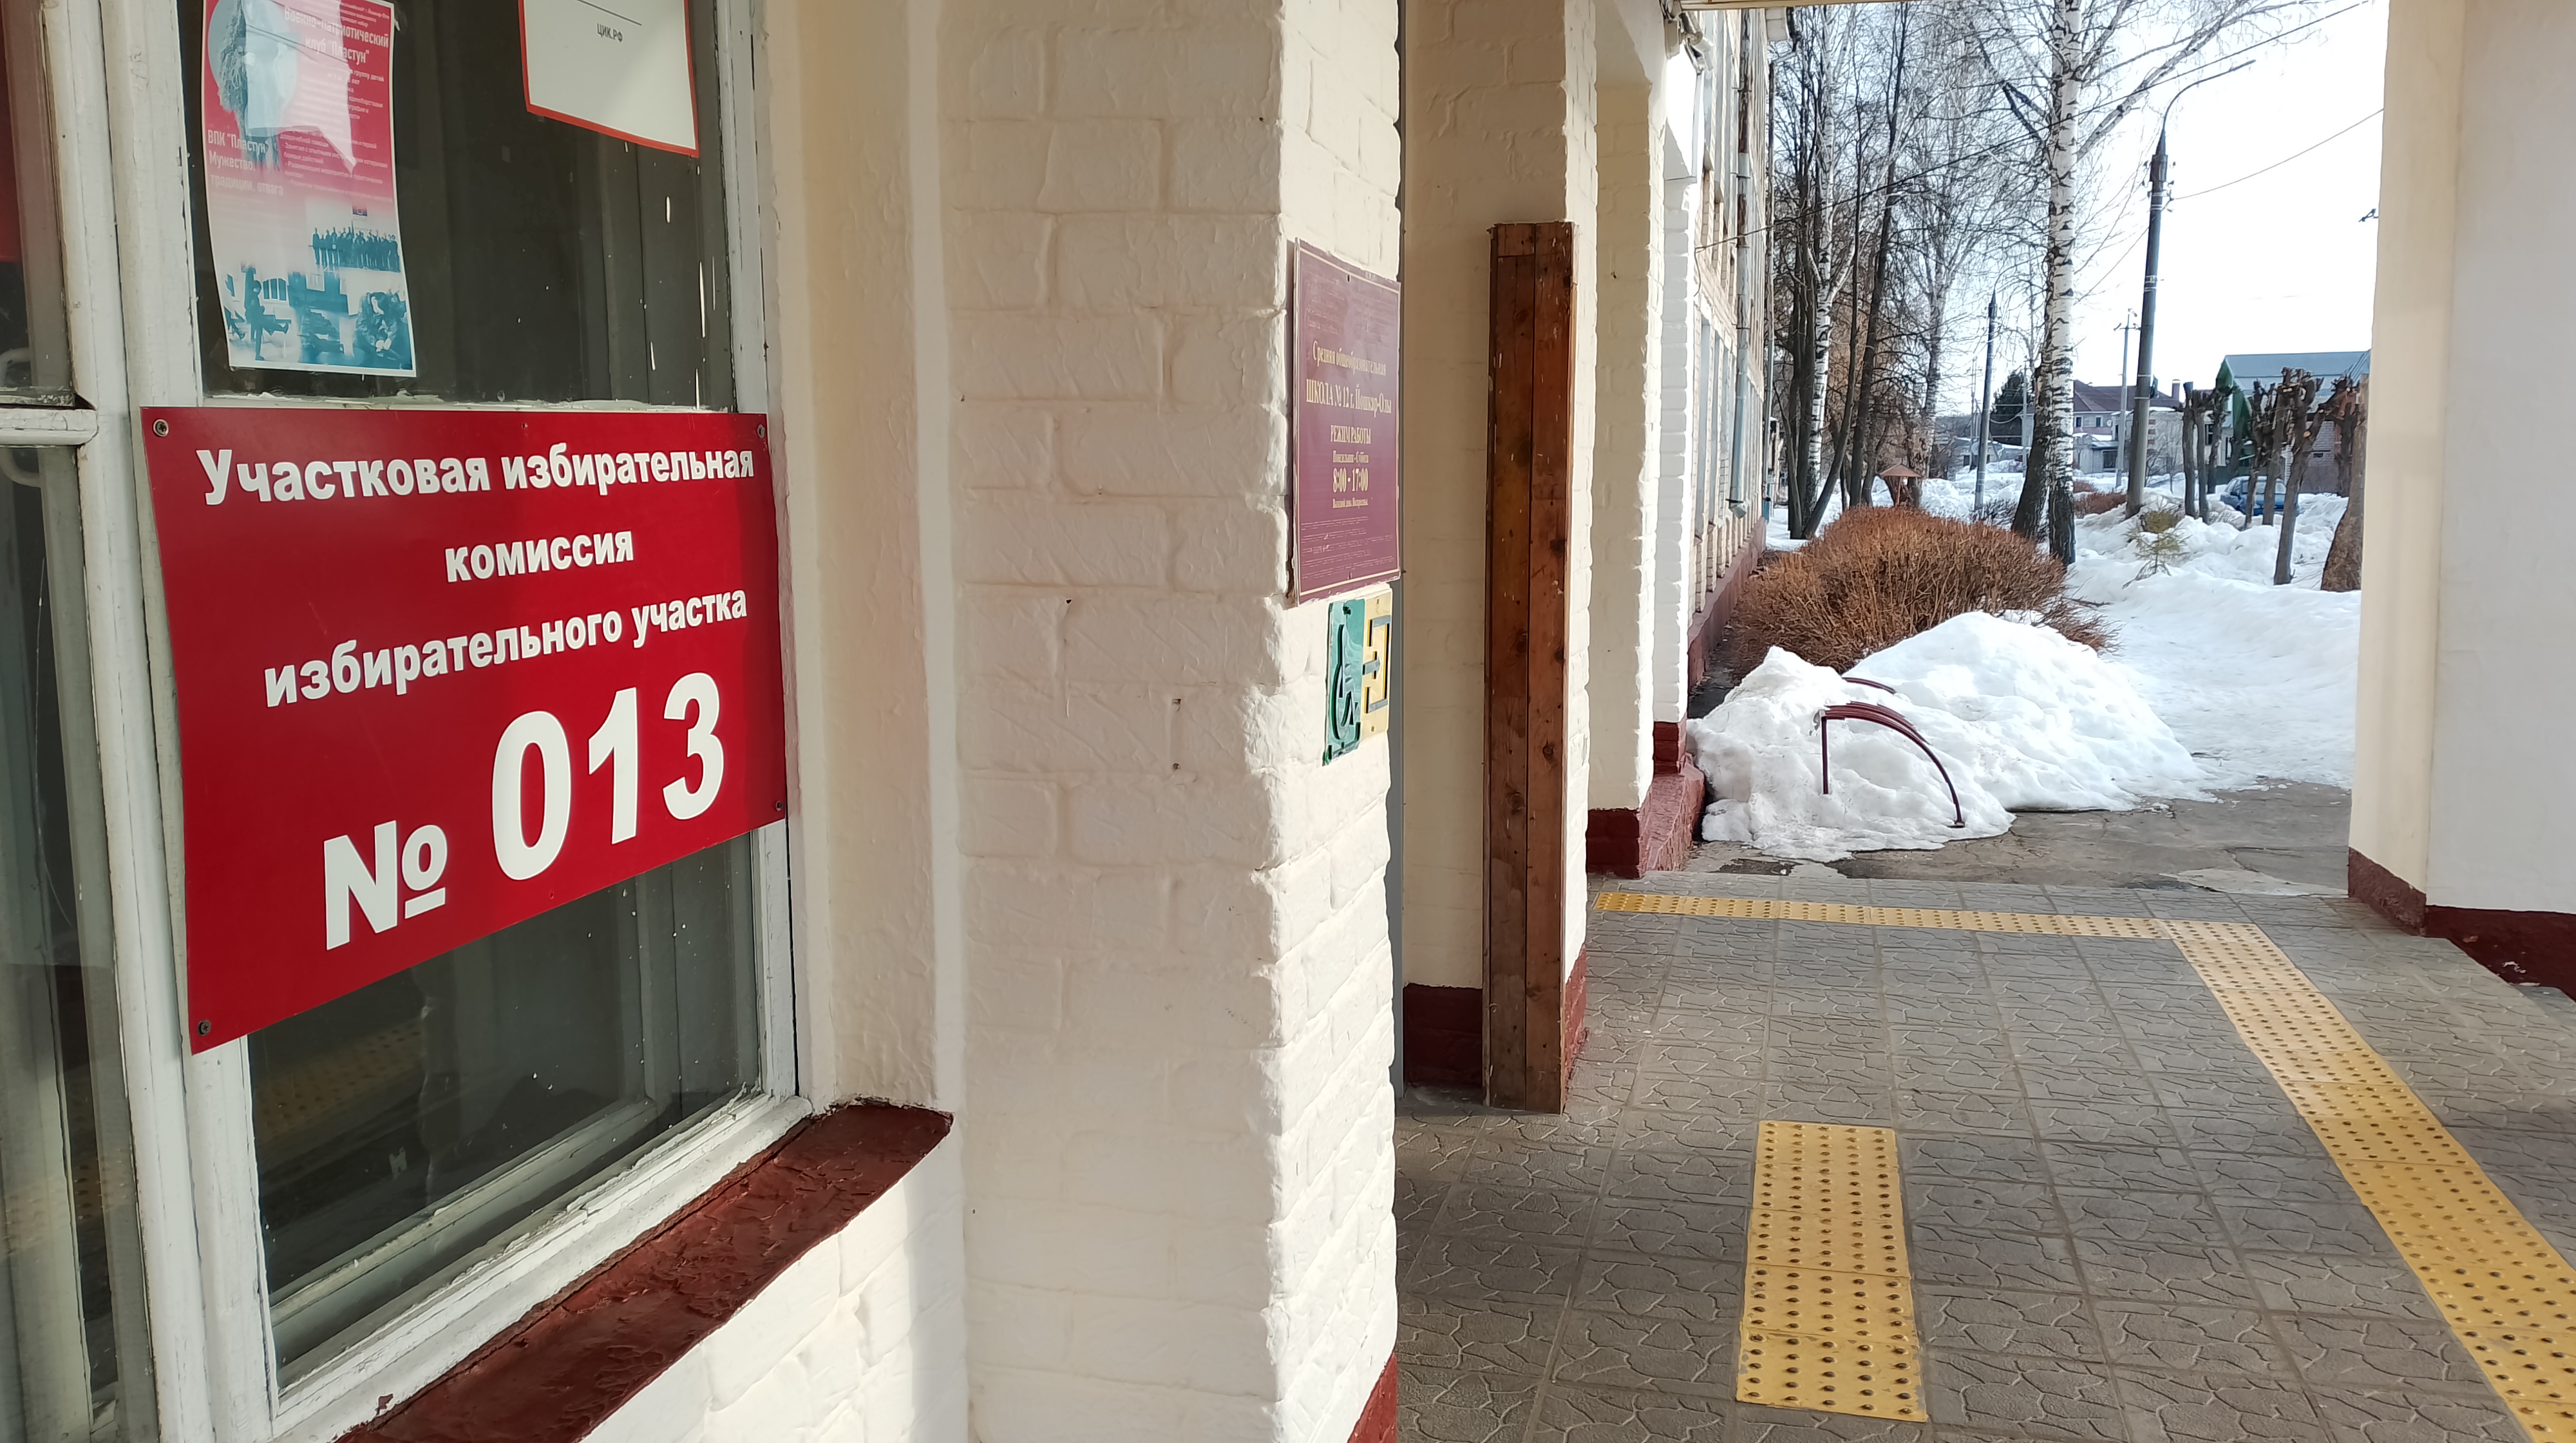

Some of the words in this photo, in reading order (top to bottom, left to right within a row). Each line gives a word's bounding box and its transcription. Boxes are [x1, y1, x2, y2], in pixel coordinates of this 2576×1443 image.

[285, 7, 389, 48] Военно-патриотический
[306, 38, 326, 54] клуб
[208, 129, 225, 146] ВПК
[209, 150, 256, 172] Мужество,
[258, 182, 283, 196] отвага
[1312, 340, 1336, 367] Средняя
[1336, 347, 1387, 376] общеобразовательная
[1306, 379, 1334, 406] ШКОЛА
[1334, 384, 1342, 407] №
[1343, 387, 1349, 408] 12
[1355, 383, 1392, 418] Йошкар-Олы
[1331, 425, 1350, 443] РЕЖИМ
[1350, 426, 1371, 444] РАБОТЫ
[196, 449, 491, 505] Участковая
[501, 442, 754, 496] избирательная
[1333, 468, 1347, 493] 8:00
[1352, 468, 1368, 492] 17:00
[445, 530, 634, 583] комиссия
[264, 611, 623, 708] избирательного
[631, 589, 748, 649] участка
[323, 819, 448, 951] №
[492, 672, 724, 881] 013
